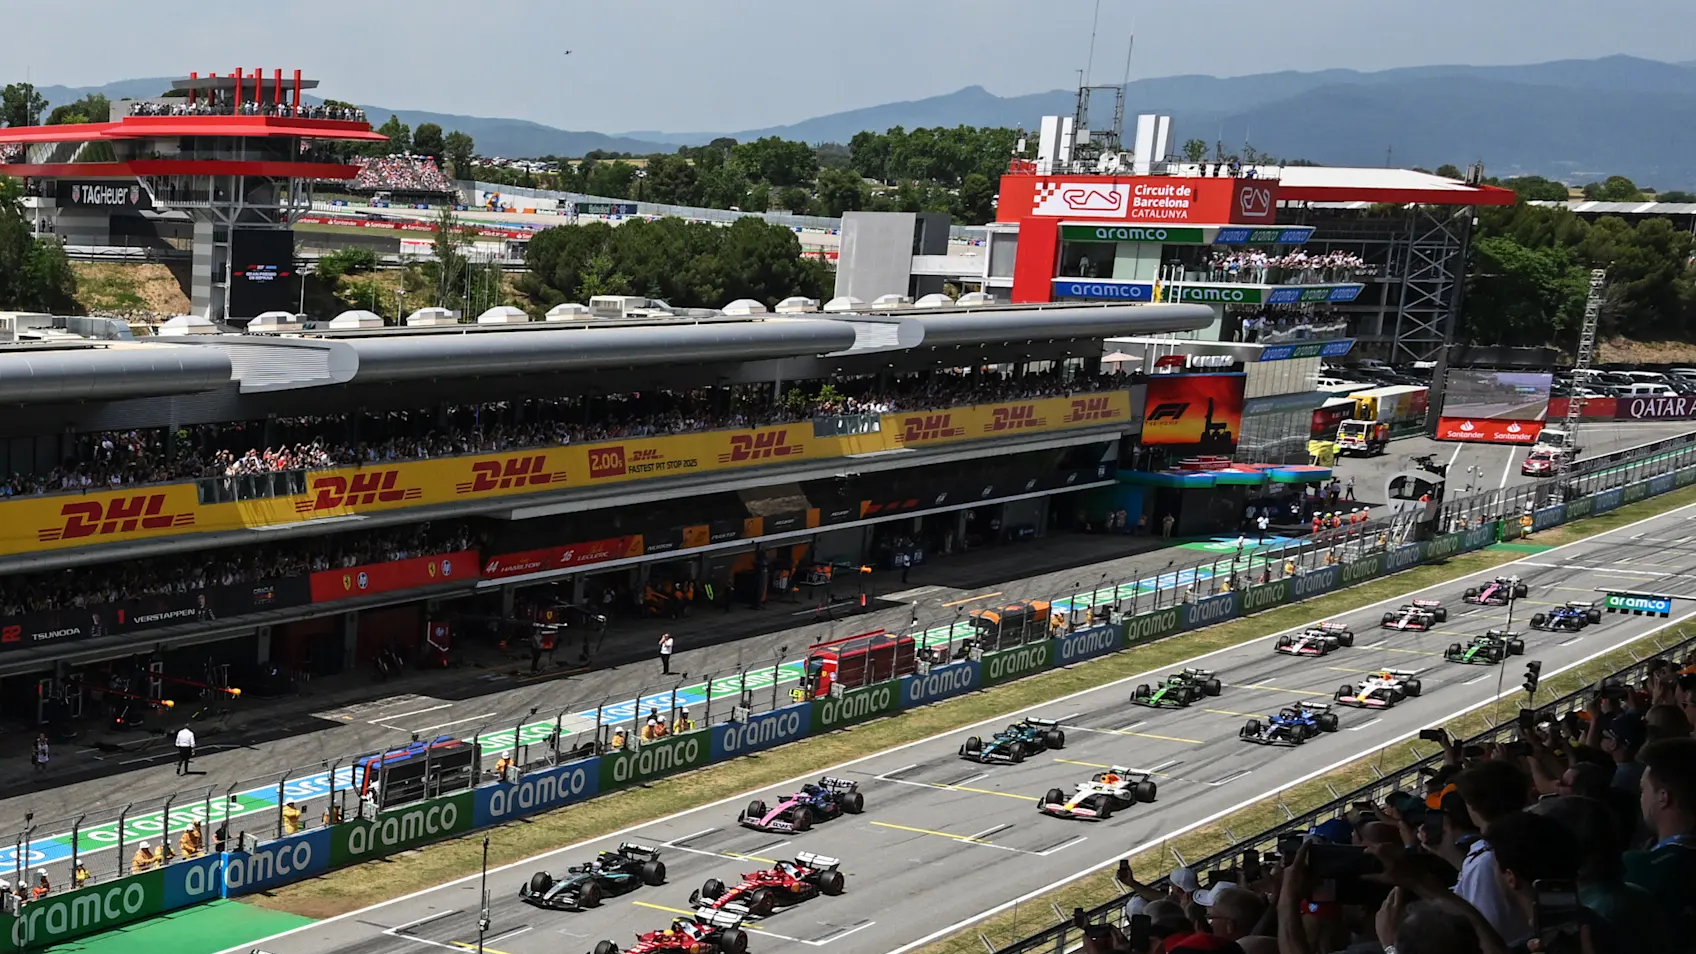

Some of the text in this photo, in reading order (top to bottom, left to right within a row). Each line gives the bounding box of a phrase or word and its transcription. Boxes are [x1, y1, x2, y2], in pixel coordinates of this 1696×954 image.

[1134, 184, 1191, 197] Circuit de
[1131, 208, 1188, 219] CATALUNYA
[1133, 197, 1189, 209] Barcelona
[1096, 228, 1167, 240] aramco
[1218, 229, 1248, 241] aramco
[1251, 229, 1279, 241] aramco
[1281, 229, 1310, 242] aramco
[1071, 284, 1141, 297] aramco
[1172, 288, 1243, 301] aramco
[1269, 288, 1299, 301] aramco
[1302, 287, 1329, 300] aramco
[1331, 285, 1359, 300] aramco
[1262, 347, 1291, 360] aramco
[992, 405, 1038, 431] DHL
[1072, 397, 1114, 421] DHL
[1630, 398, 1686, 419] QATAR
[905, 414, 956, 441] DHL
[1447, 430, 1485, 439] Santander
[1493, 432, 1532, 440] Santander
[633, 450, 658, 460] DHL
[730, 430, 793, 461] DHL
[591, 452, 623, 472] 2.00s
[628, 459, 698, 474] FASTEST PIT STOP 2025
[472, 456, 553, 491] DHL
[314, 471, 406, 510] DHL
[61, 494, 176, 539] DHL
[577, 552, 609, 561] LECLERC
[1387, 547, 1419, 569] aramco
[501, 562, 541, 573] HAMILTON
[1343, 558, 1378, 580] aramco
[1295, 571, 1333, 592] aramco
[1244, 583, 1285, 609] aramco
[1610, 597, 1665, 609] aramco
[134, 608, 196, 624] VERSTAPPEN
[1188, 595, 1232, 624] aramco
[32, 627, 81, 641] TSUNODA
[1128, 611, 1176, 641] aramco
[1062, 627, 1114, 659] aramco
[989, 645, 1046, 675] aramco
[910, 665, 973, 701] aramco
[821, 688, 891, 725] aramco
[724, 711, 800, 751] aramco
[613, 738, 698, 782] aramco
[490, 767, 586, 818] aramco
[87, 797, 246, 843] aramco
[348, 801, 457, 856] aramco
[184, 840, 312, 896] aramco
[11, 882, 145, 948] aramco
